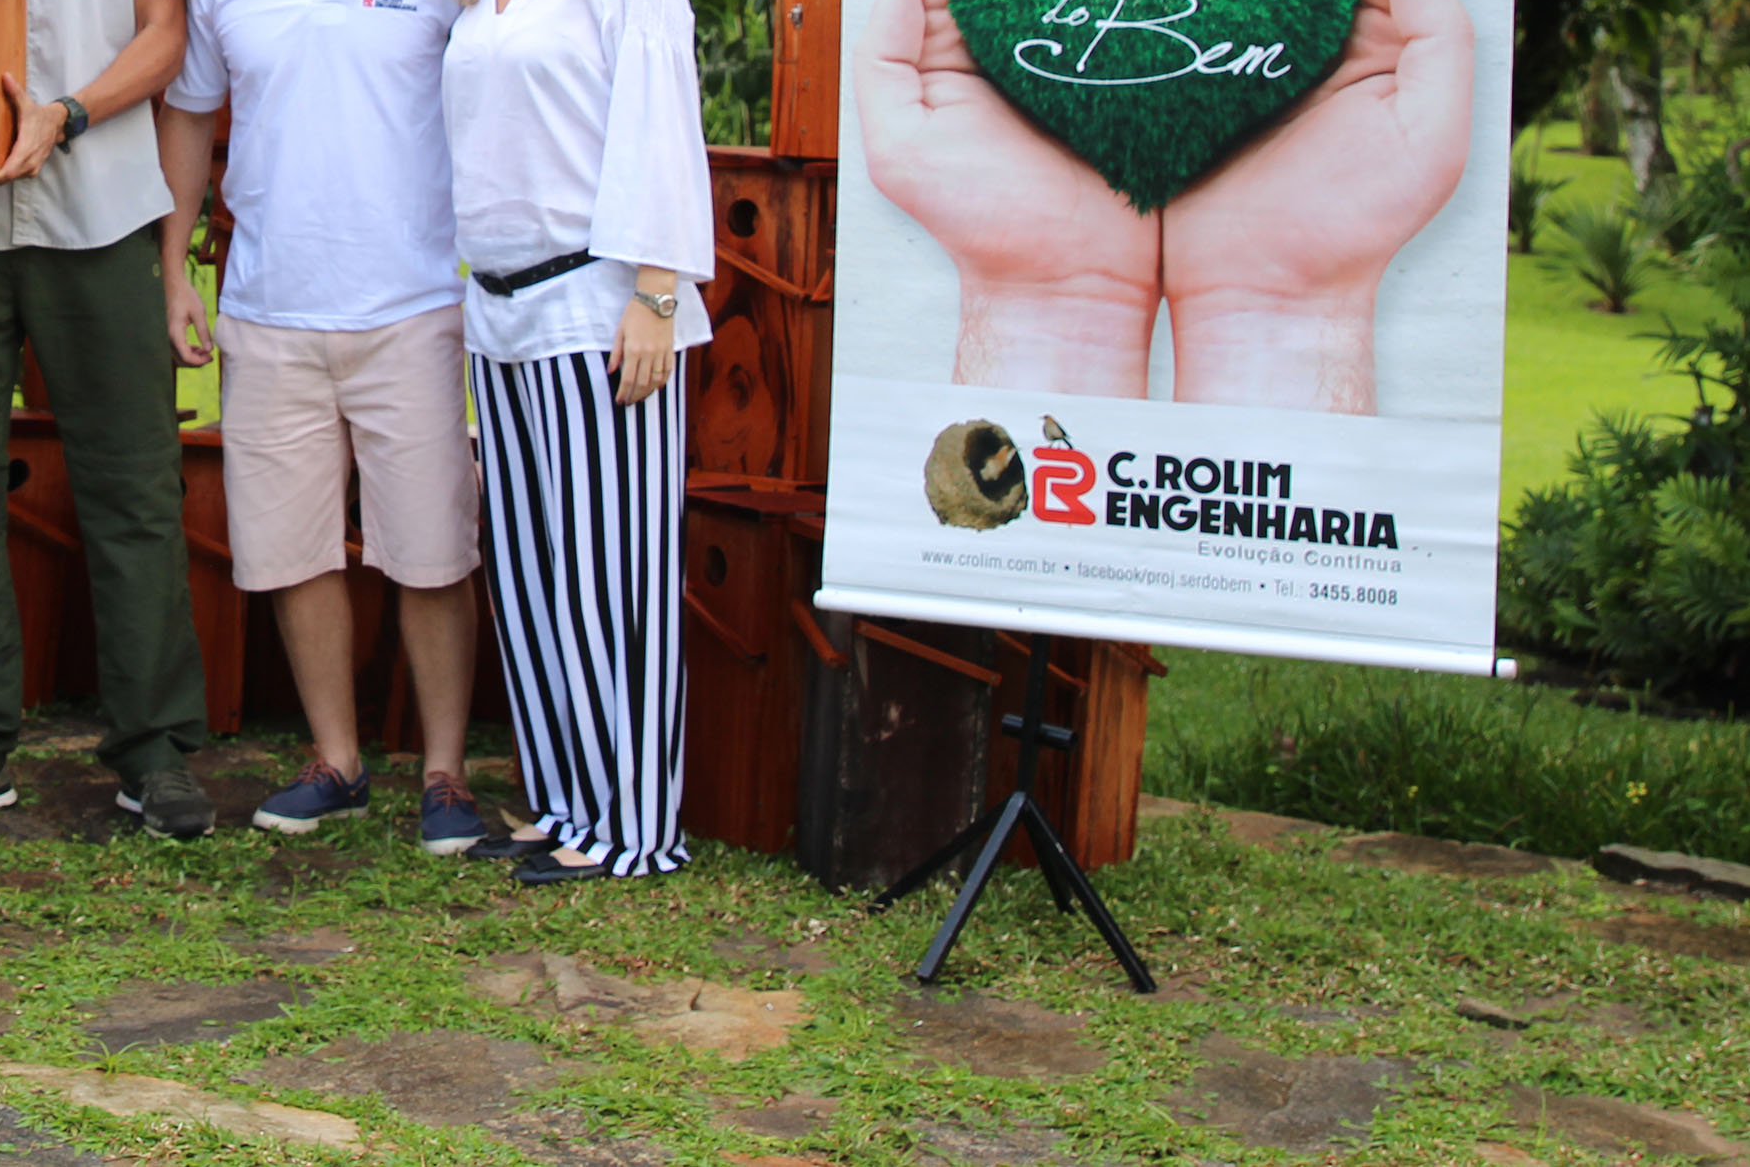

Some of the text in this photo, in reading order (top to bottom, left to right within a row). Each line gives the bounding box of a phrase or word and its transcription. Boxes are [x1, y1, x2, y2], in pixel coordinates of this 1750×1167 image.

[1106, 491, 1399, 550] ENGENHARIA
[921, 549, 1057, 575] www.crolim.com.br
[1077, 561, 1252, 594] facebook/proj.serdobem
[1309, 582, 1399, 606] 3455.8008
[1197, 540, 1295, 565] Evolução
